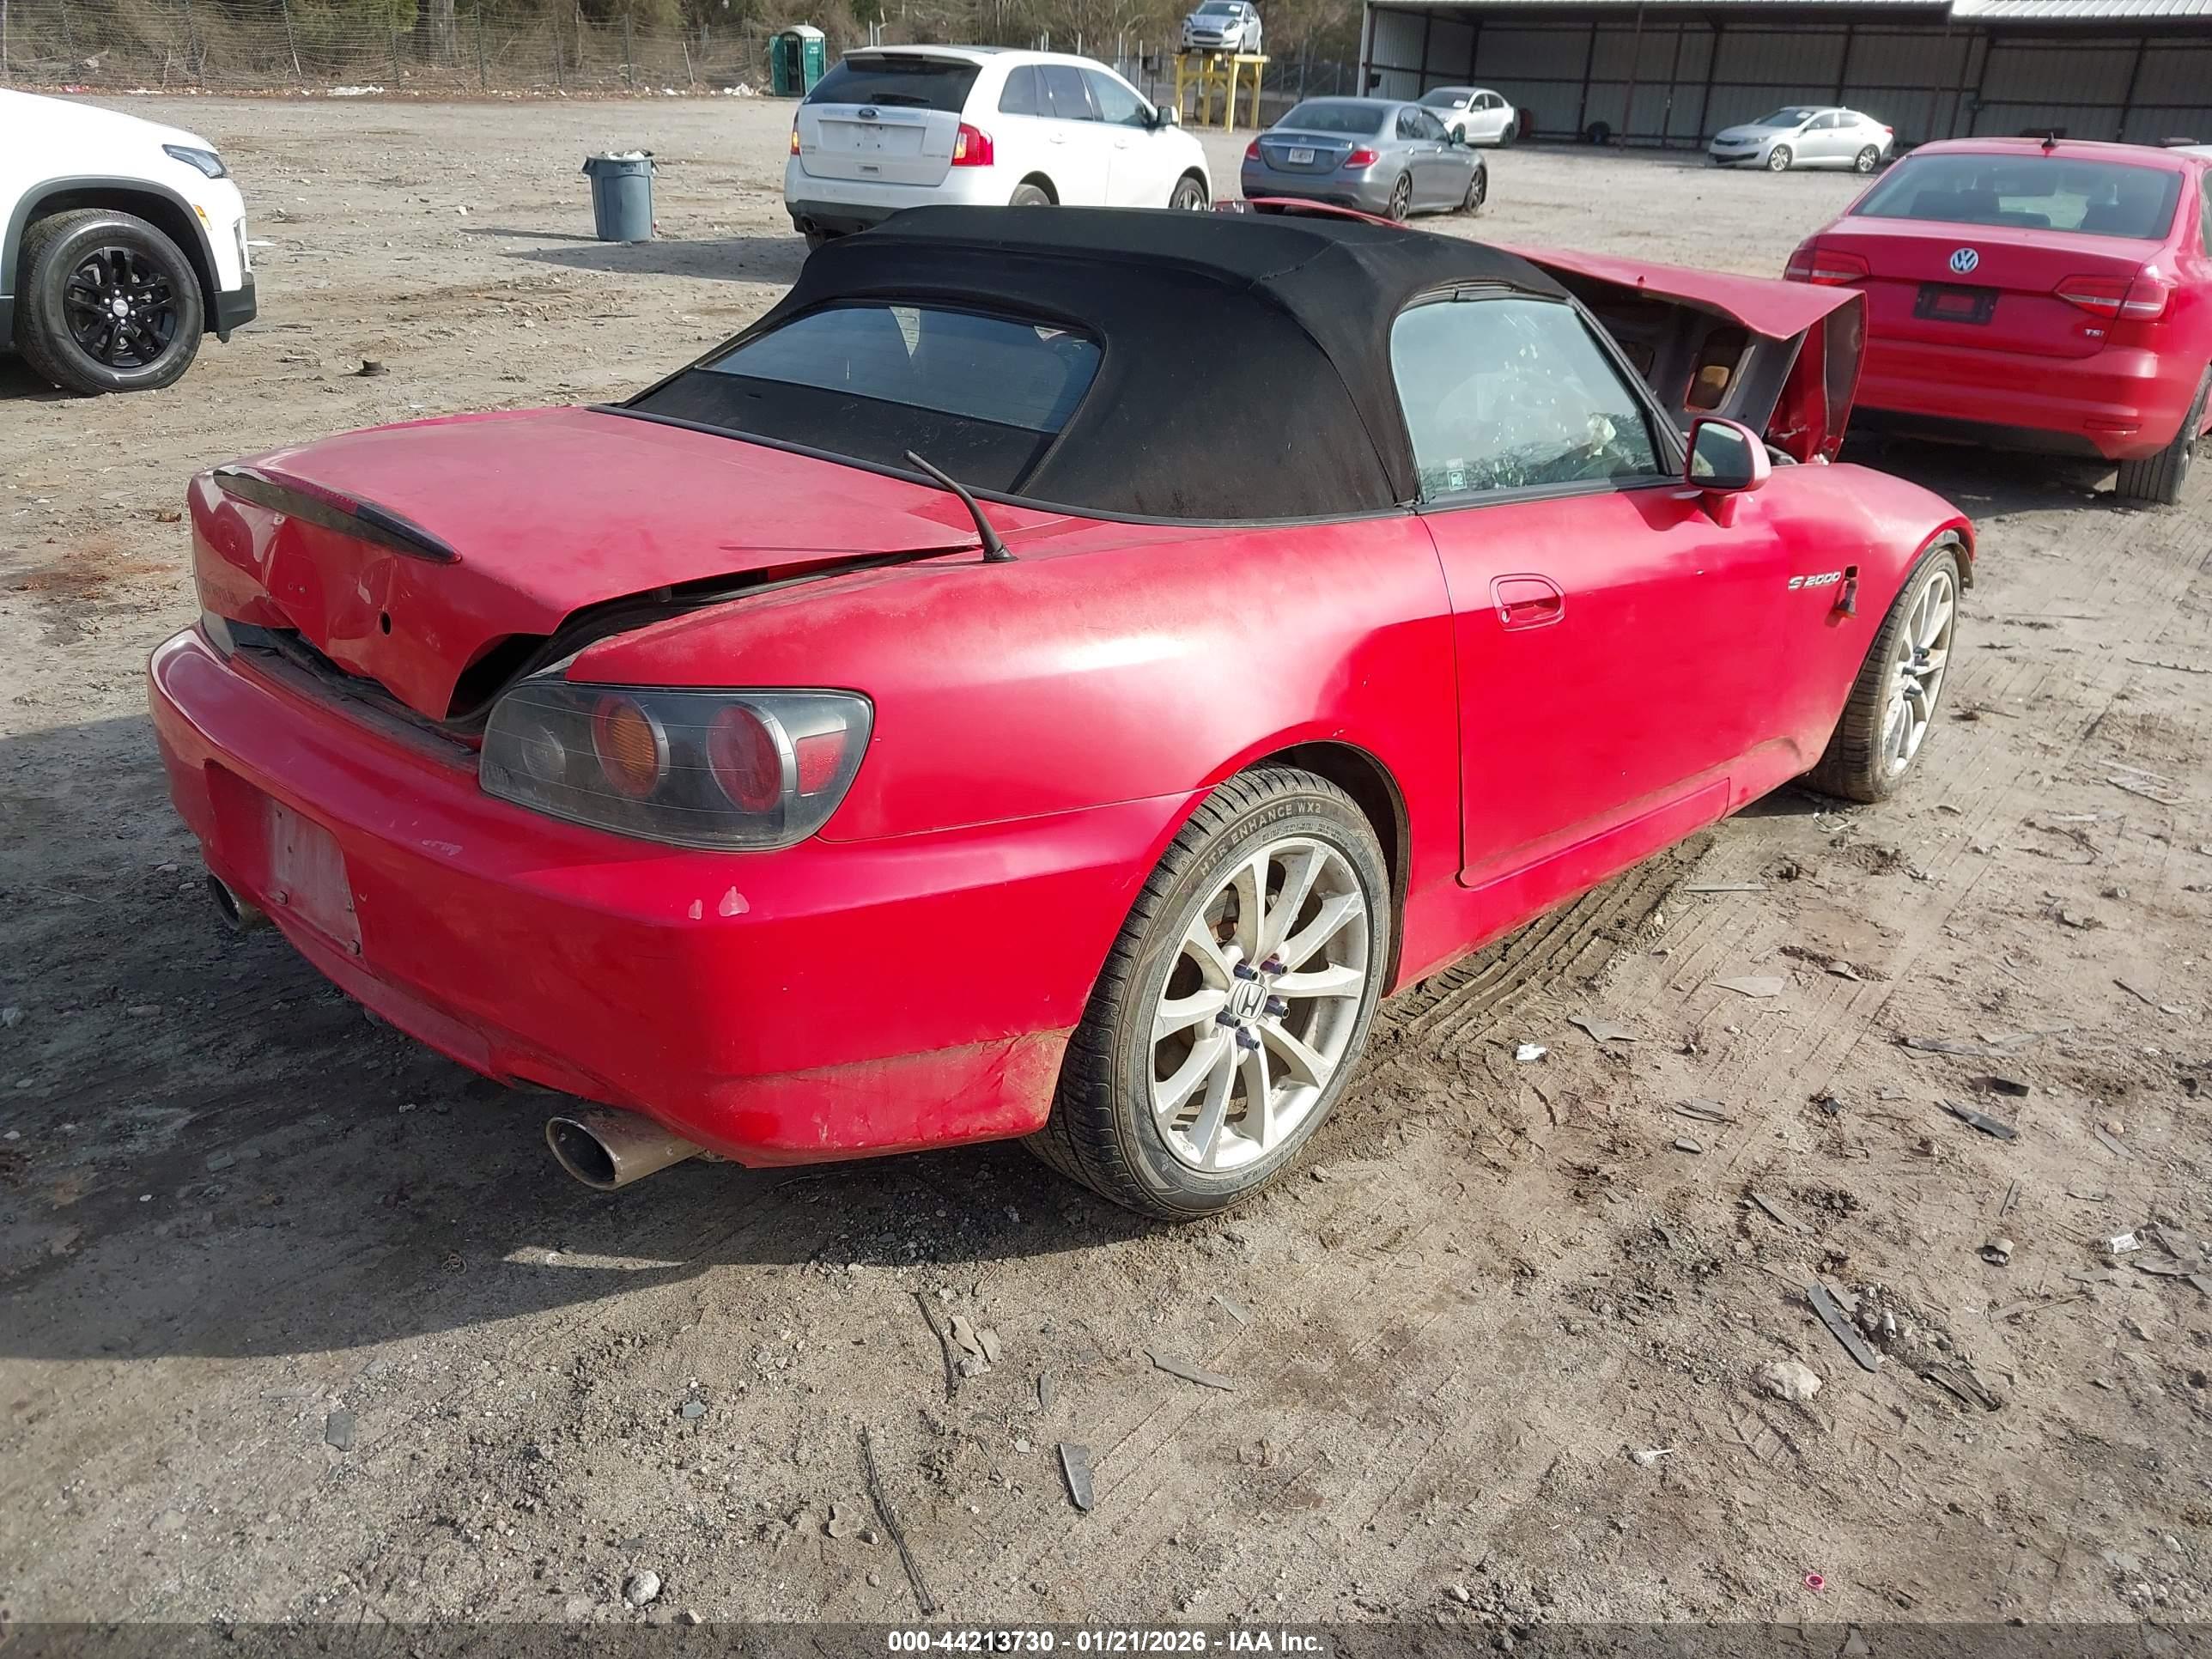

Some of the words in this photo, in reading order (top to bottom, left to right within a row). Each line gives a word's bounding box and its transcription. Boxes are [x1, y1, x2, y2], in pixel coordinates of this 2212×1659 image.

[1804, 571, 1841, 588] 2000
[1200, 846, 1229, 876] HTR
[1231, 805, 1292, 844] ENHANCE
[1297, 801, 1322, 814] WX2
